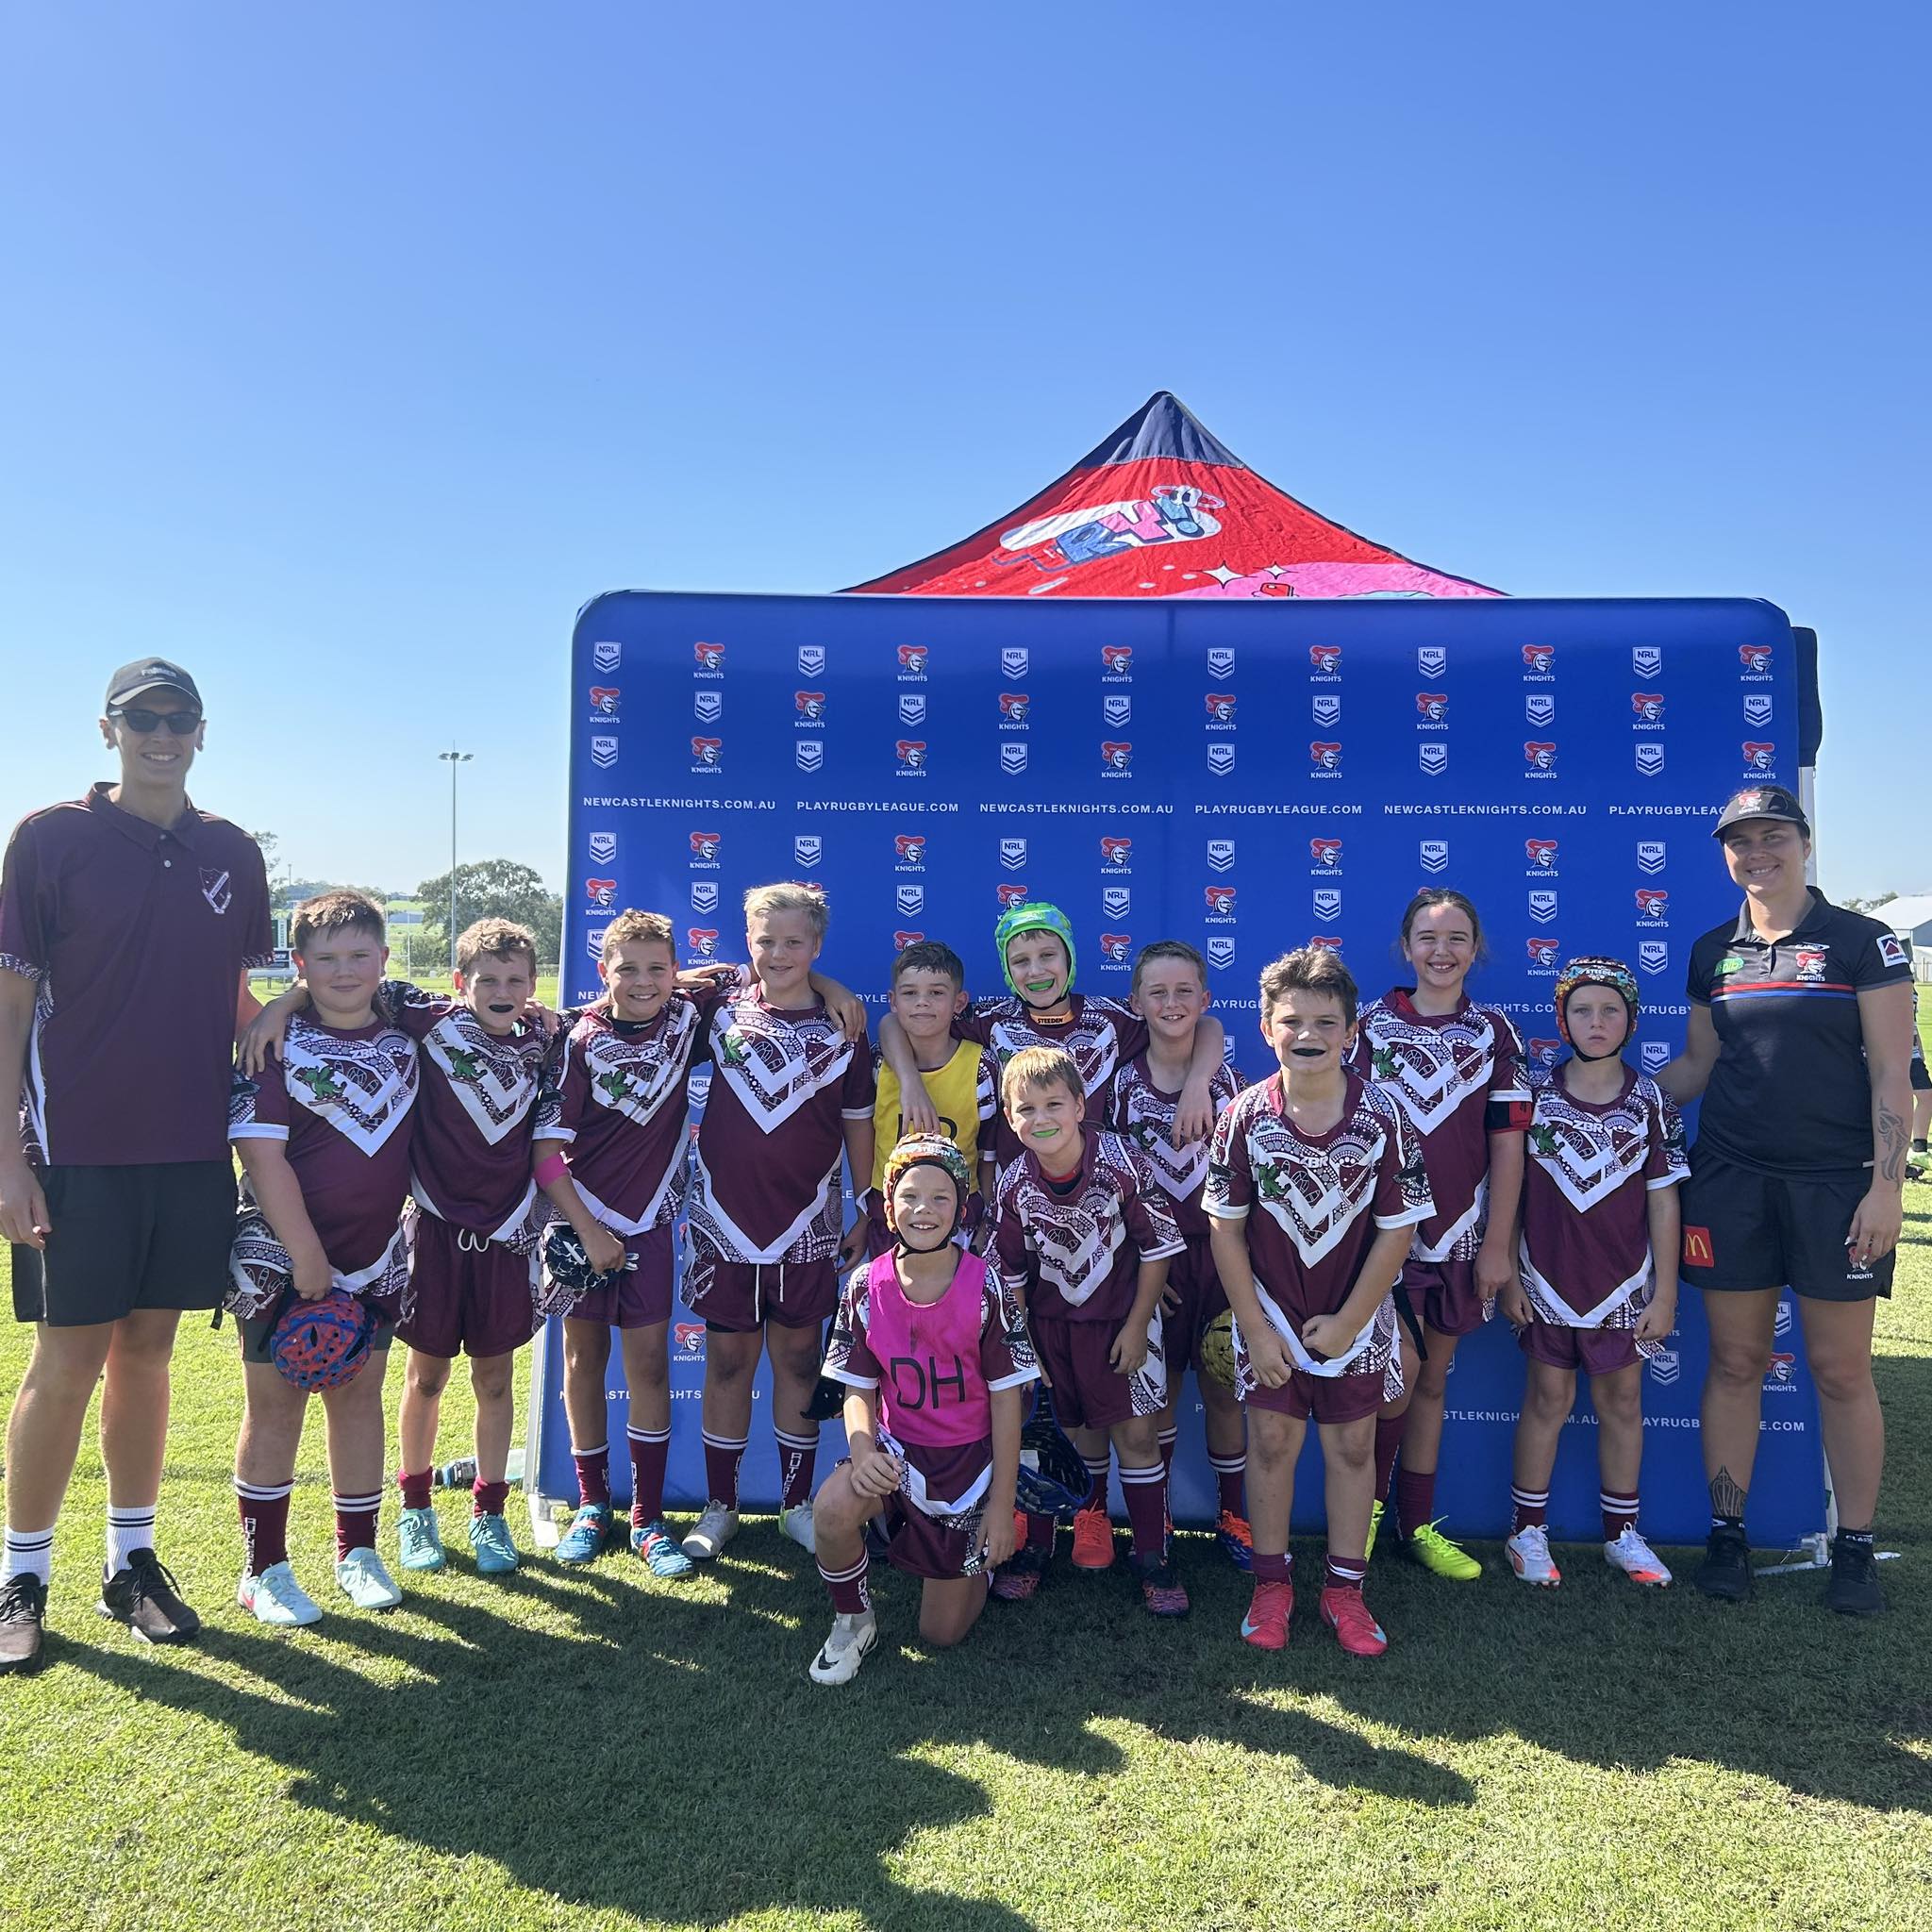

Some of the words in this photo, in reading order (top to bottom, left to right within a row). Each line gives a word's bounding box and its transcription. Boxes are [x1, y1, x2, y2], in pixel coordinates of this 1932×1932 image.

[1006, 747, 1023, 755] NRL
[583, 797, 776, 810] NEWCASTLEKNIGHTS.COM.AU
[797, 801, 959, 812] PLAYRUGBYLEAGUE.COM
[980, 804, 1174, 814] NEWCASTLEKNIGHTS.COM.AU
[1195, 805, 1362, 815] PLAYRUGBYLEAGUE.COM
[1384, 804, 1587, 816] NEWCASTLEKNIGHTS.COM.AU
[1609, 805, 1725, 816] PLAYRUGBYLEAG
[1425, 845, 1443, 853] NRL
[1642, 846, 1661, 854] NRL
[1107, 892, 1125, 900] NRL
[1534, 894, 1552, 903] NRL
[1644, 945, 1663, 953] NRL
[766, 1027, 796, 1039] ZBR
[1412, 1035, 1441, 1045] ZBR
[350, 1047, 378, 1059] ZBR
[1645, 1047, 1665, 1055] NRL
[1572, 1119, 1604, 1133] ZBR
[1300, 1155, 1329, 1169] ZBR
[1655, 1355, 1674, 1363] NRL
[890, 1355, 966, 1411] DH
